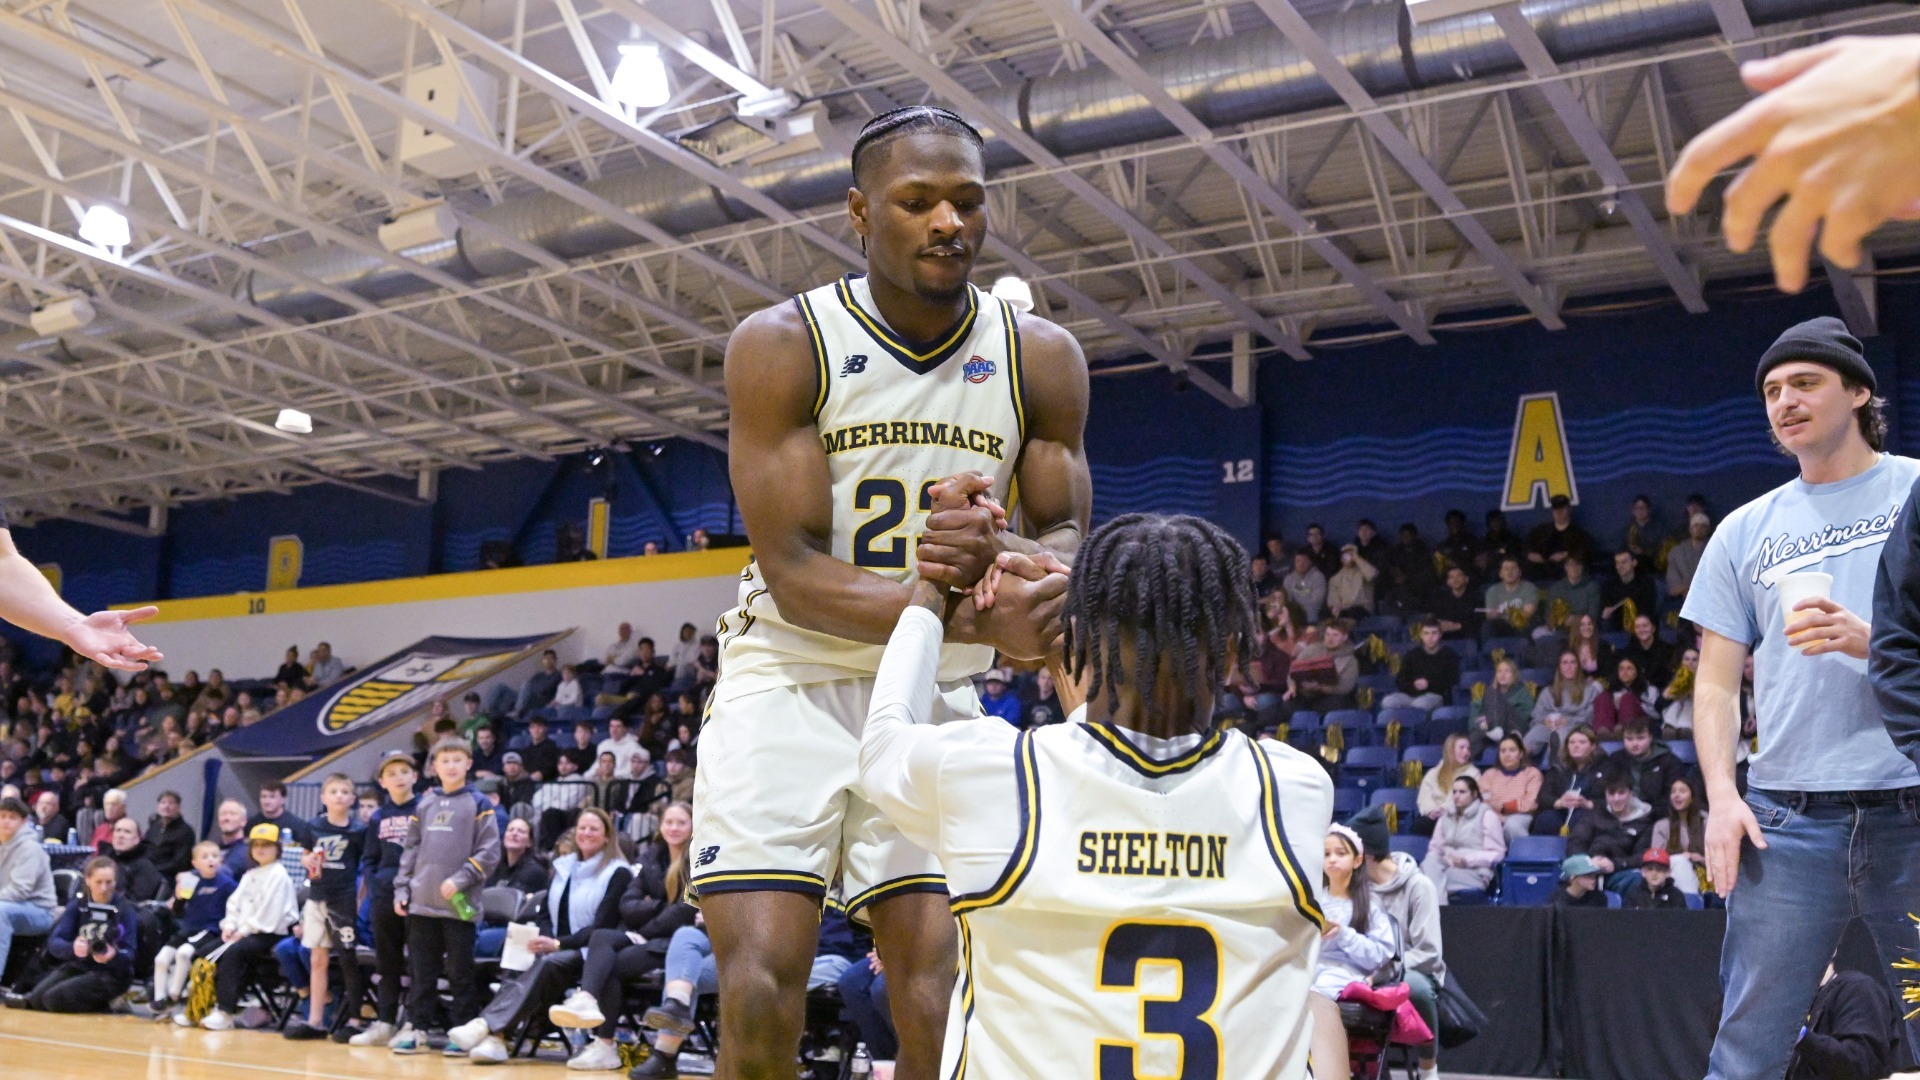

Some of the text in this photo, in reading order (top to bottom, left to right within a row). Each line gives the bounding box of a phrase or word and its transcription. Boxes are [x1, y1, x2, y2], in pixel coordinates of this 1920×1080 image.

[822, 420, 1006, 462] MERRIMACK
[1501, 391, 1580, 512] A
[1223, 459, 1254, 484] 12
[1751, 504, 1900, 584] Merrimack
[248, 597, 266, 614] 10
[1077, 829, 1229, 880] SHELTON
[1094, 917, 1225, 1080] 3
